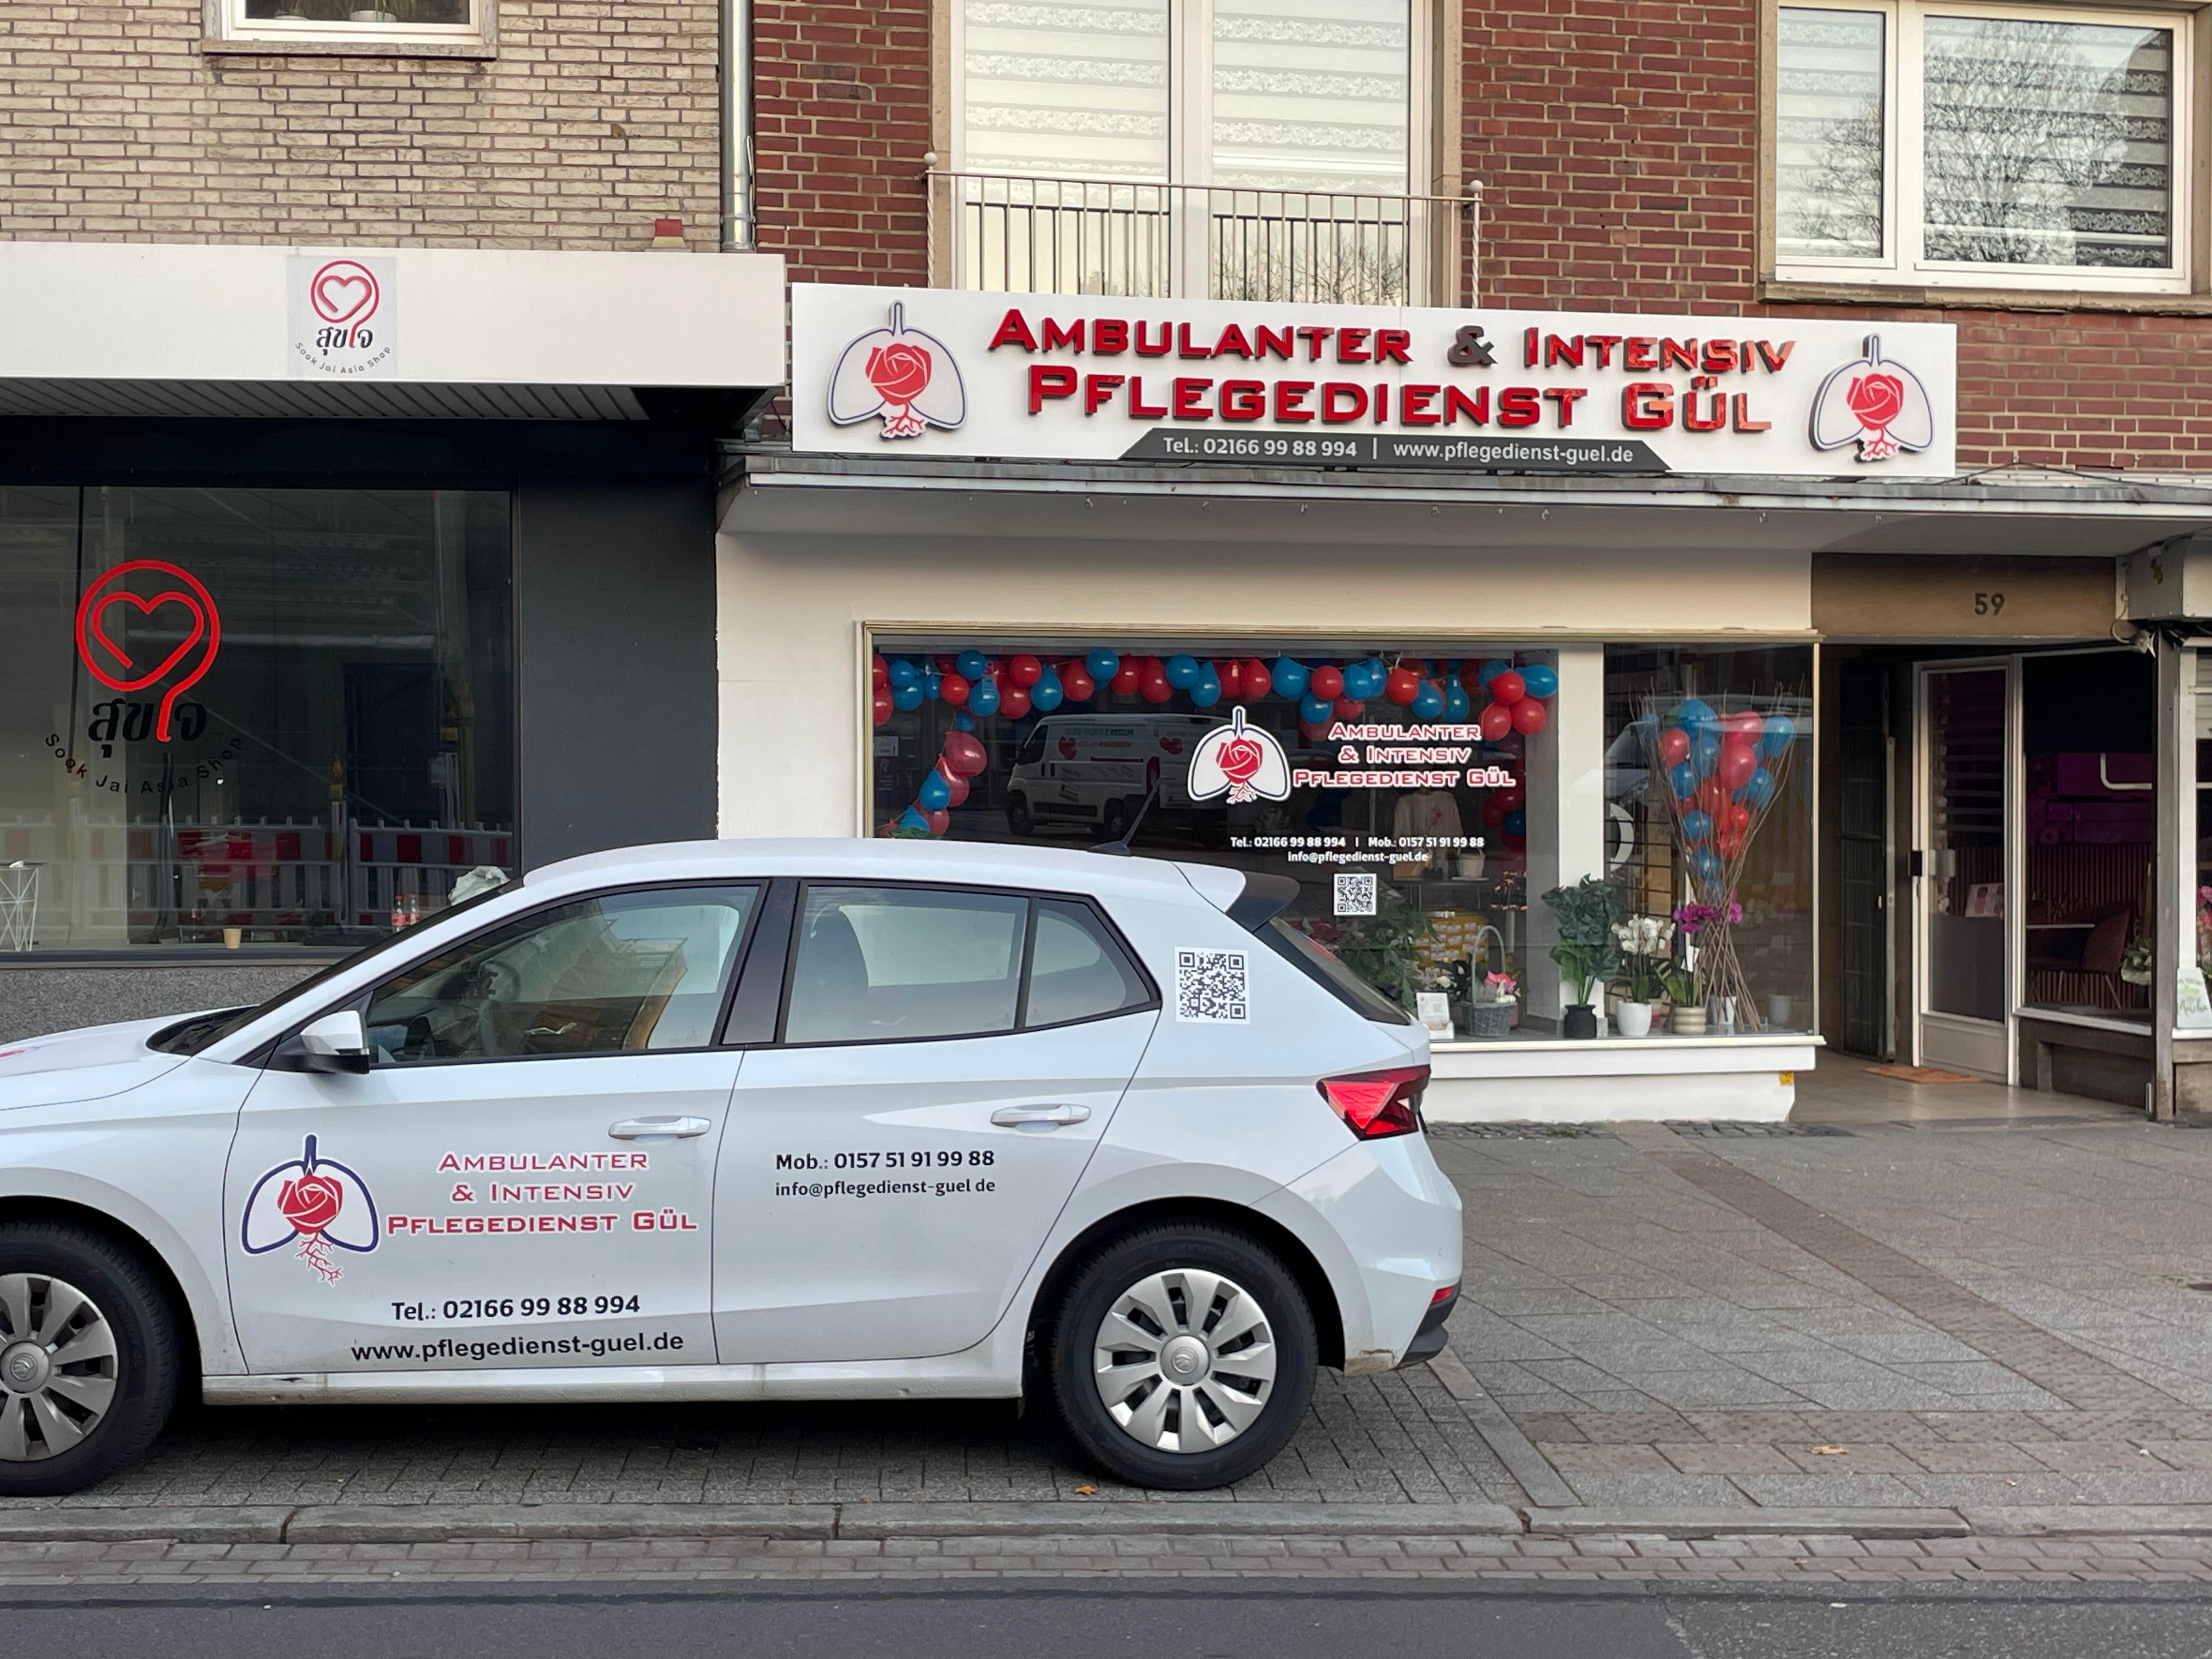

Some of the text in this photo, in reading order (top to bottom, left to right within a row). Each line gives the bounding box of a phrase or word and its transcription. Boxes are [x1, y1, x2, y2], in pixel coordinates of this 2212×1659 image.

[988, 308, 1796, 374] AMBULANTER & INTENSIV
[295, 342, 391, 374] Sook Jai Asia Shop
[1028, 364, 1773, 431] PFLEGEDIENST GÜL
[1163, 437, 1199, 454] Tel.:
[1204, 437, 1260, 456] 02166
[1264, 439, 1288, 456] 99
[1292, 441, 1317, 456] 88
[1321, 441, 1358, 458] 994
[1393, 442, 1634, 466] www.pflegedienst-guel.de
[1974, 592, 2005, 616] 59
[1329, 723, 1482, 741] AMBULANTER
[45, 733, 241, 794] Sook Jai Asia Shop
[1339, 746, 1472, 764] & INTENSIV
[1293, 767, 1516, 787] PFLEGEDIENST GÜL
[1231, 837, 1252, 847] Tel.:
[1254, 837, 1288, 847] 02166
[1290, 837, 1305, 847] 99
[1306, 837, 1322, 847] 88
[1323, 837, 1346, 847] 994
[1368, 837, 1396, 847] Mob.:
[1399, 837, 1424, 847] 0157
[1426, 837, 1437, 847] 51
[1439, 837, 1451, 847] 91
[1453, 837, 1468, 847] 99
[1469, 837, 1484, 847] 88
[1288, 851, 1427, 864] info@pflegedienst-guel.de
[438, 1153, 648, 1172] AMBULANTER
[776, 1150, 995, 1170] Mob.: 0157 51 91 99 88
[452, 1183, 635, 1202] & INTENSIV
[387, 1209, 698, 1234] PFLEGEDIENST GÜL
[391, 1295, 640, 1320] Tel.: 02166 99 88 994
[351, 1332, 684, 1363] www.pflegedienst-guel.de
